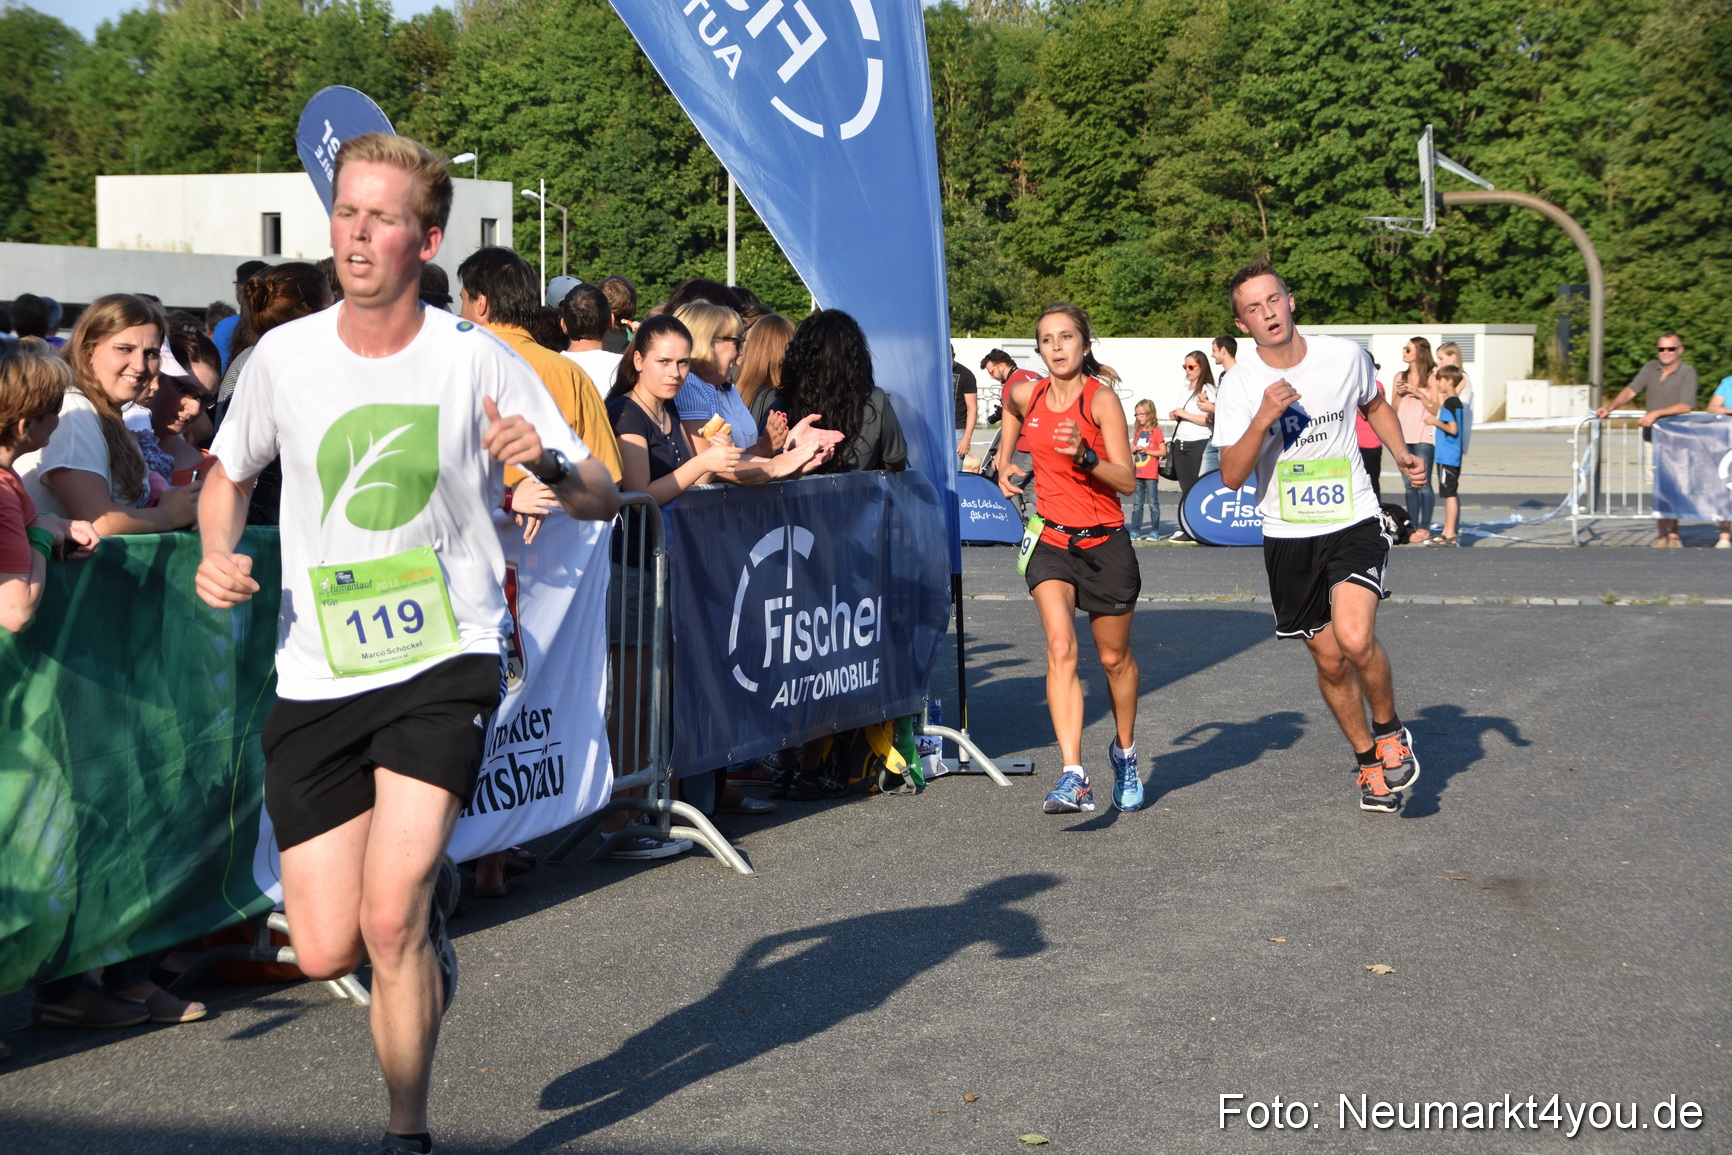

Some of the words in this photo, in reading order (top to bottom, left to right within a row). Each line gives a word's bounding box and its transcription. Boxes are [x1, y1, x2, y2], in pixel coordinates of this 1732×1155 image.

[1294, 431, 1328, 448] Team
[961, 499, 977, 508] das
[1286, 484, 1345, 506] 1468
[970, 510, 991, 522] fährt
[1022, 536, 1031, 556] 9
[345, 598, 424, 645] 119
[361, 649, 385, 660] Marco
[386, 640, 423, 655] Schöckel
[770, 658, 880, 709] AUTOMOBILE
